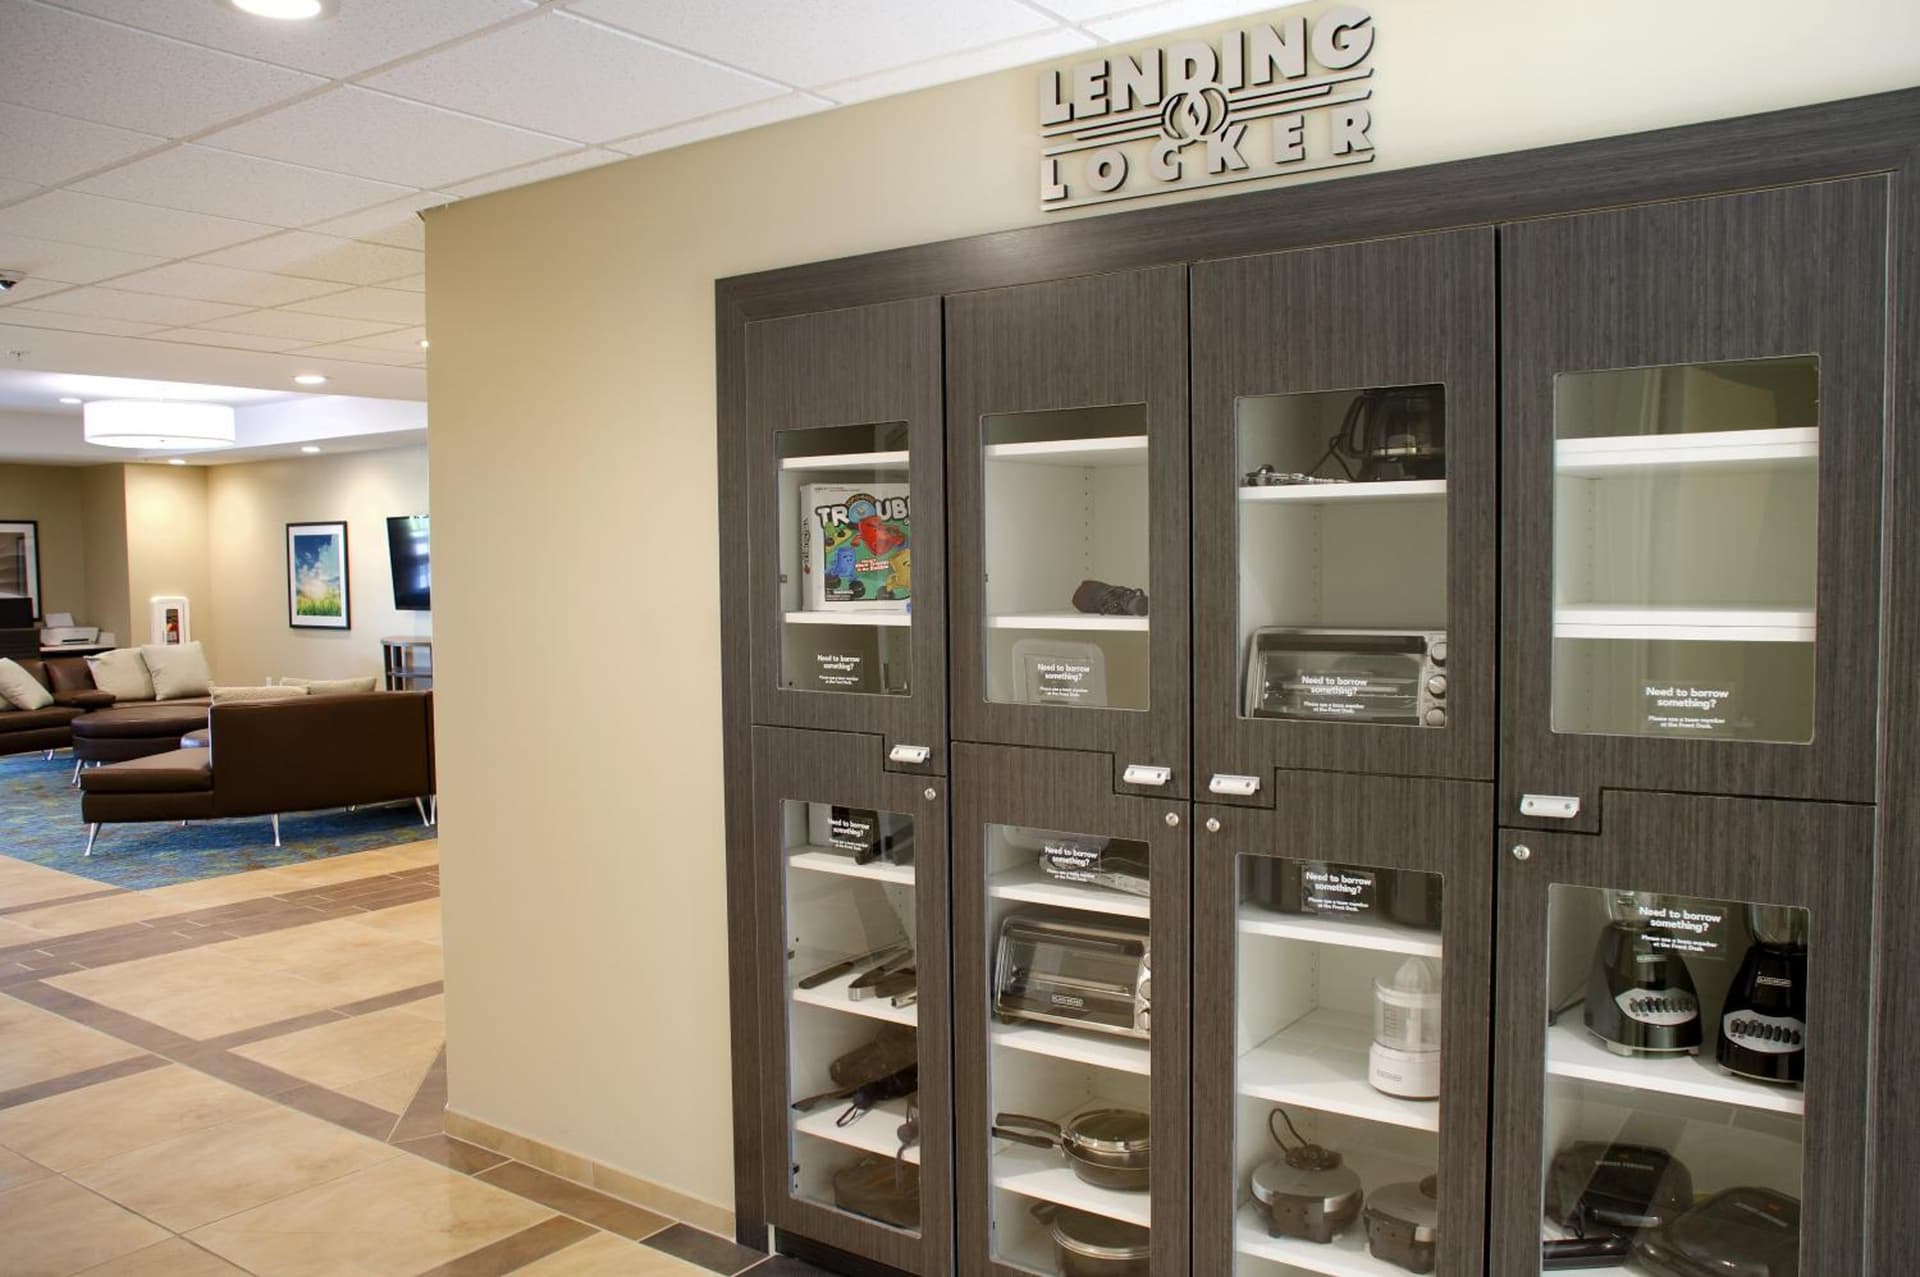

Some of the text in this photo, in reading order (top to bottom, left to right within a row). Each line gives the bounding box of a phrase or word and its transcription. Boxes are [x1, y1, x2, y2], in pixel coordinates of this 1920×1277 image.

[1039, 7, 1375, 126] LENDING
[1040, 107, 1375, 201] LOCKER
[1302, 675, 1367, 686] Need to borrow
[1311, 685, 1358, 696] something?
[1646, 687, 1729, 698] Need to borrow
[1657, 698, 1717, 710] something?
[1306, 872, 1328, 881] Need
[1341, 875, 1371, 886] borrow
[1315, 883, 1362, 895] something?
[1639, 906, 1721, 923] Need to borrow
[1650, 919, 1709, 933] something?
